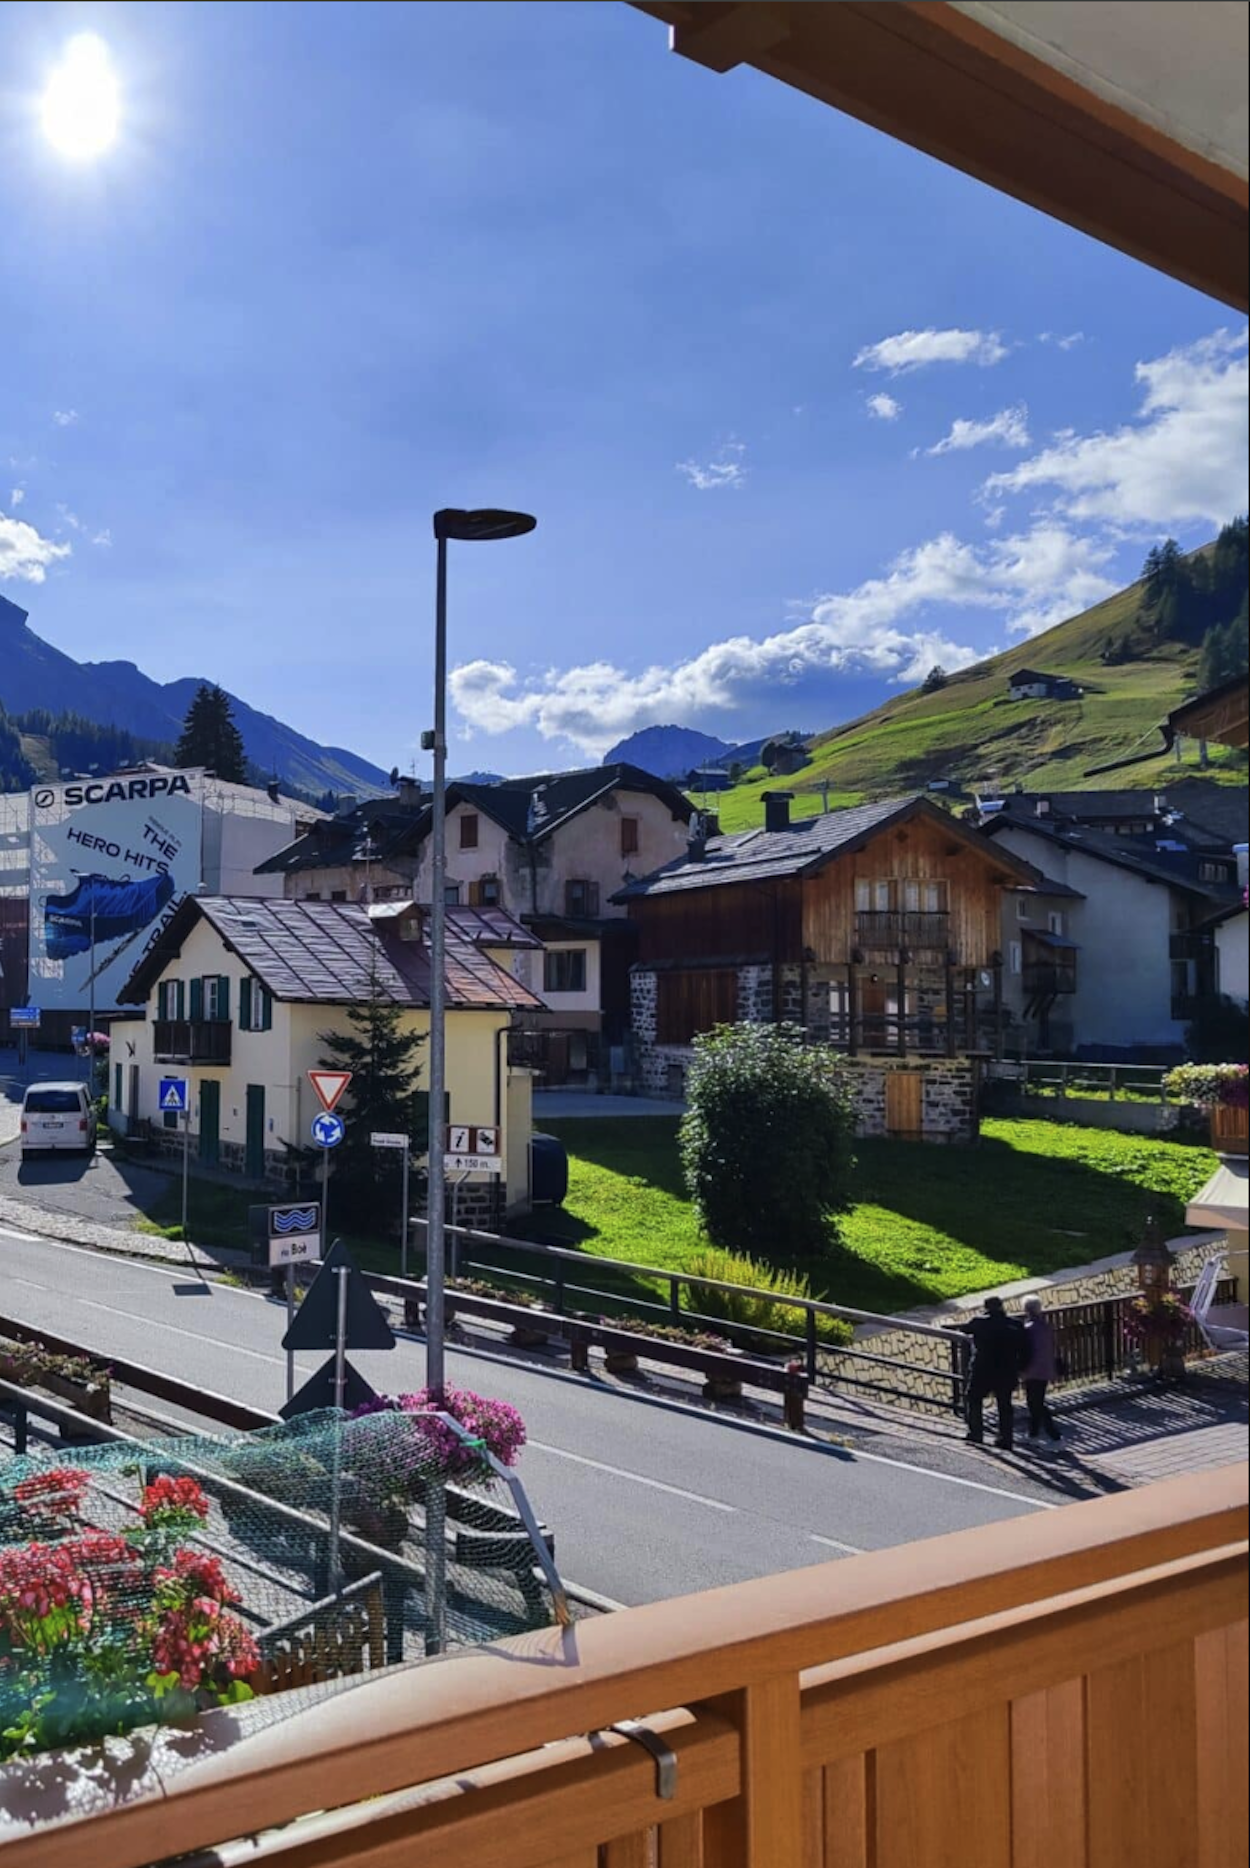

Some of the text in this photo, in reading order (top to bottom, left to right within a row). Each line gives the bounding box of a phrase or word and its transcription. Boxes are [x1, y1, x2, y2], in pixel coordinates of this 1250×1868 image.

[64, 775, 191, 806] SCARPA
[66, 827, 120, 857] HERO
[123, 850, 169, 875] HITS
[143, 823, 178, 861] THE
